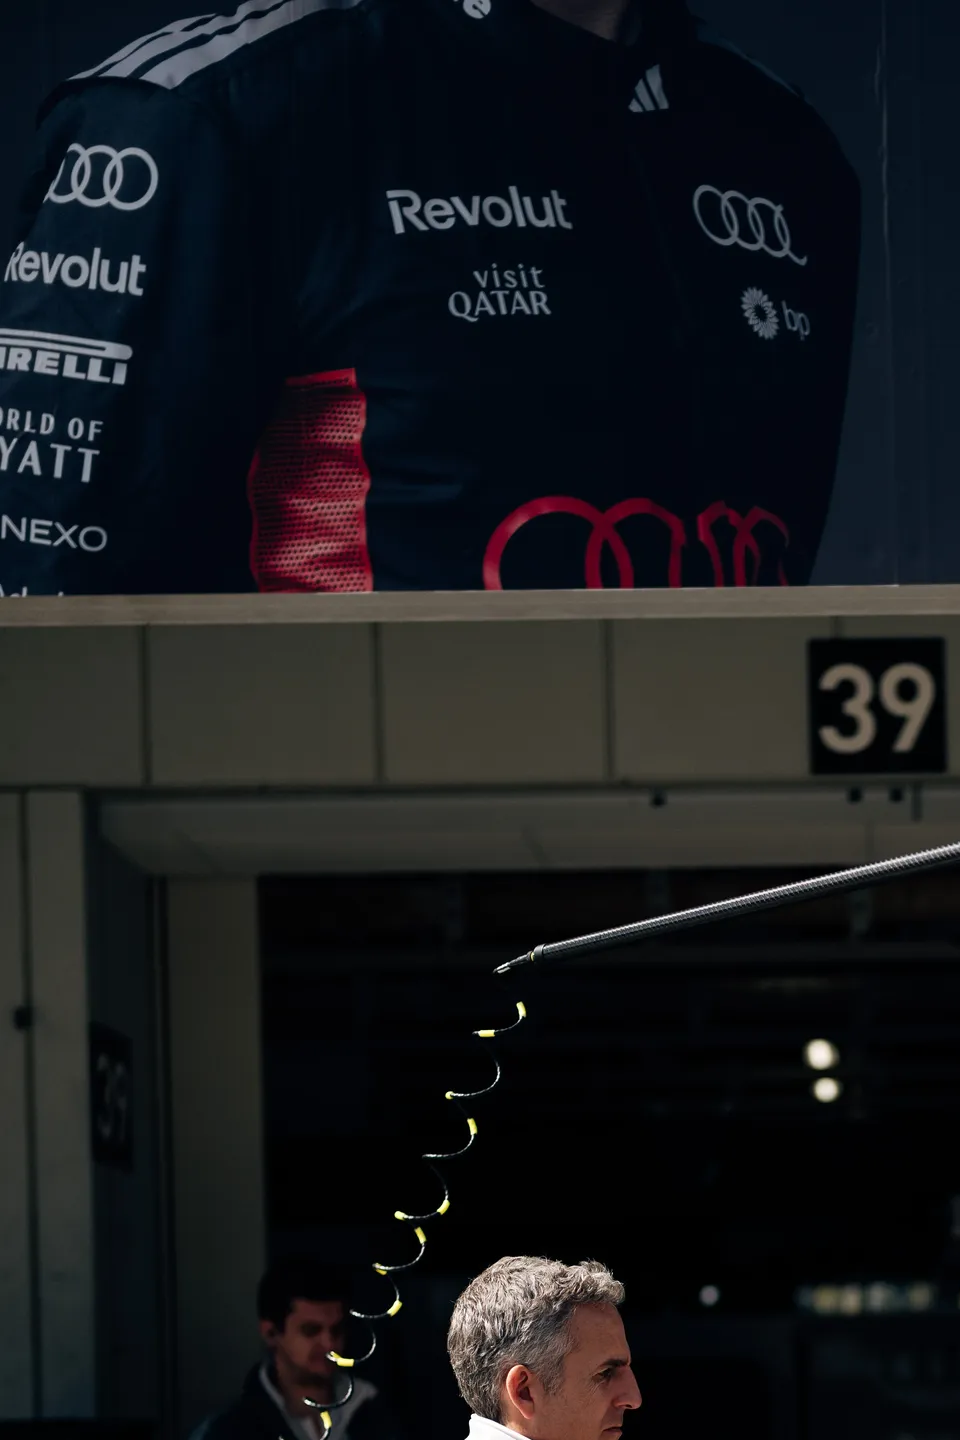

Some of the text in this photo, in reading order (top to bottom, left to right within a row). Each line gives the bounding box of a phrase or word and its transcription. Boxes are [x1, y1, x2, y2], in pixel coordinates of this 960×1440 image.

[386, 186, 572, 235] Revolut
[4, 241, 147, 297] Revolut
[473, 263, 545, 289] visit
[448, 290, 552, 322] QATAR
[781, 300, 811, 341] bp
[0, 328, 133, 385] IRELLI
[0, 405, 104, 442] RLD OF
[1, 514, 108, 552] NEXO
[818, 662, 936, 755] 39
